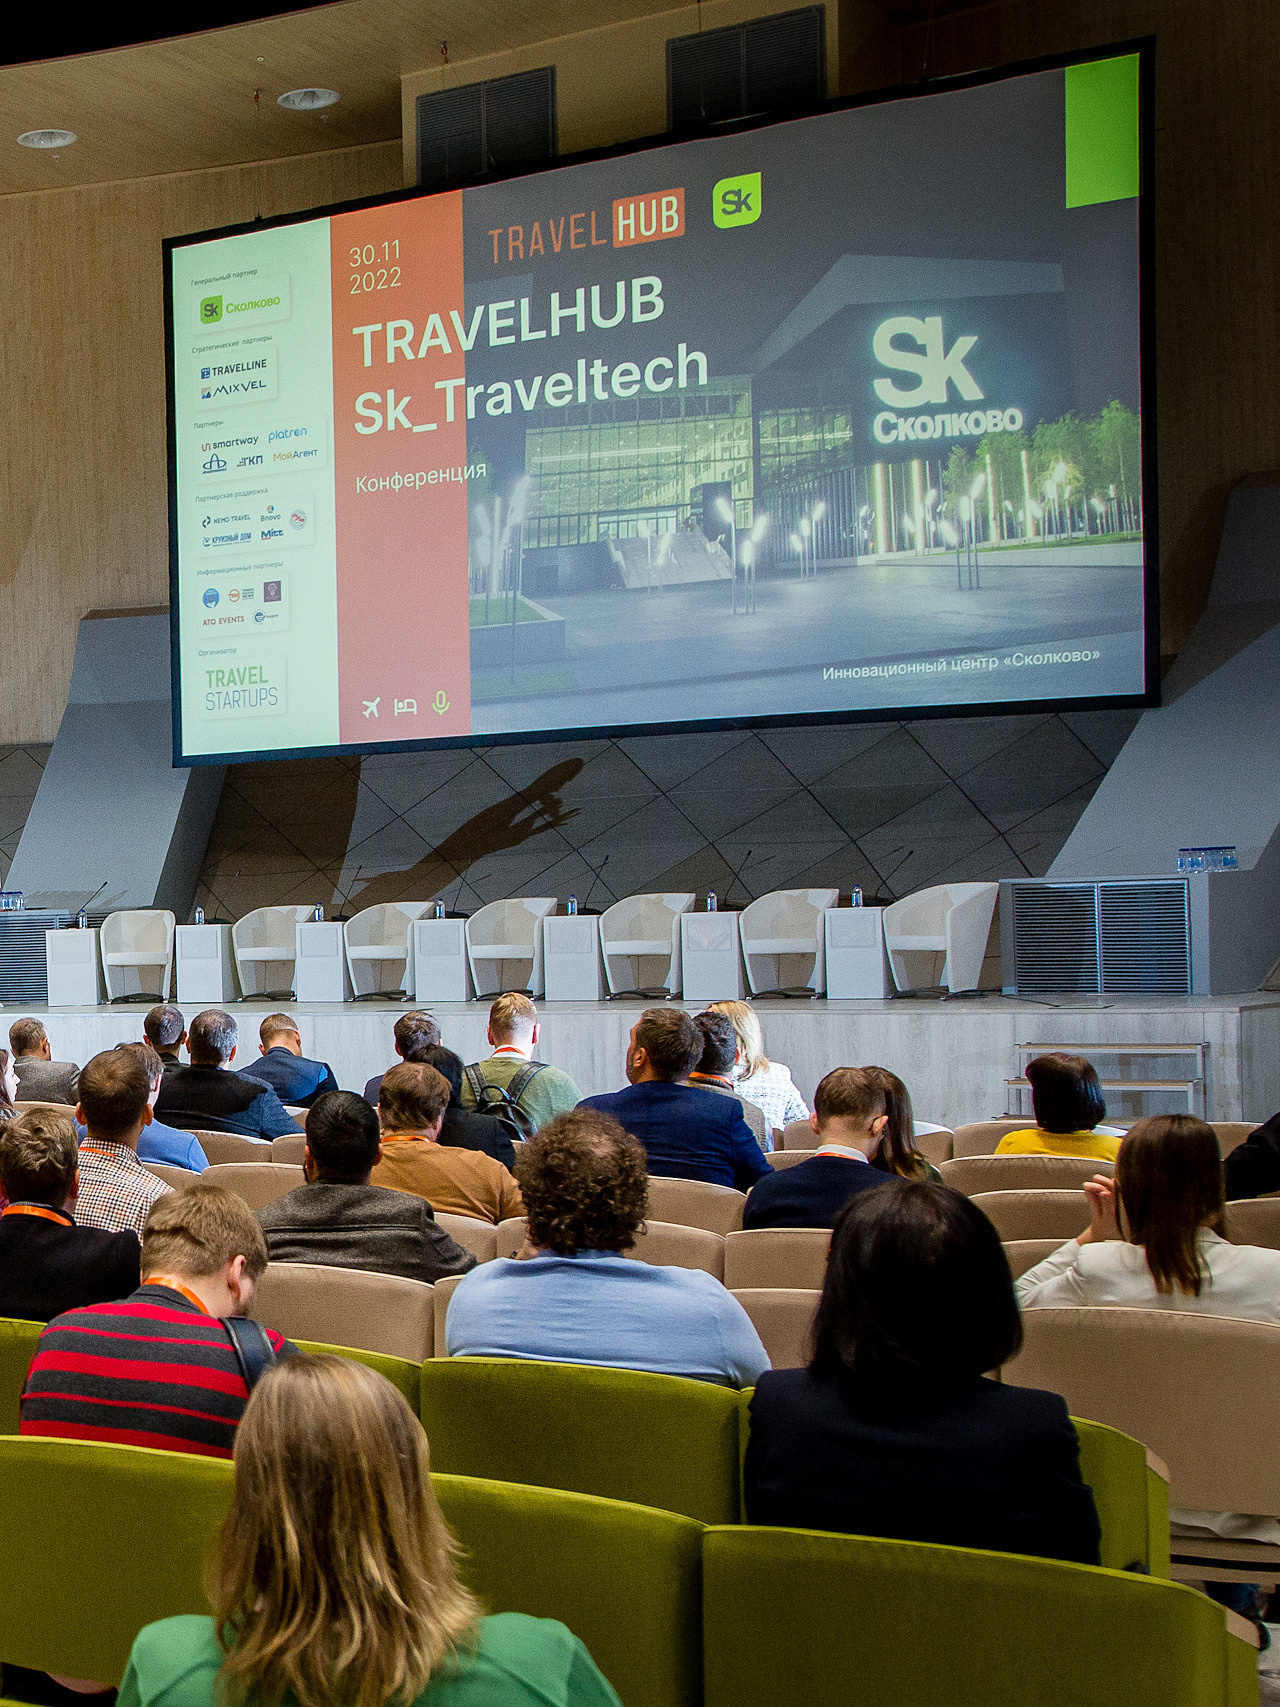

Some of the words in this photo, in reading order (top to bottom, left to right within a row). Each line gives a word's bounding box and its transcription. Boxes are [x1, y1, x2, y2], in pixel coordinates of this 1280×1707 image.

[721, 189, 753, 216] Sk
[488, 211, 607, 263] TRAVEL
[618, 196, 679, 241] HUB
[349, 239, 399, 267] 30.11
[190, 272, 232, 286] Генеральный
[232, 269, 258, 278] партнер
[349, 266, 401, 294] 2022
[204, 303, 219, 318] Sk
[226, 296, 281, 314] Сколково
[352, 275, 665, 367] TRAVELHUB
[191, 340, 240, 354] Стратегические
[212, 358, 267, 376] TRAVELLINE
[872, 316, 984, 408] Sk
[354, 342, 708, 435] Sk_Traveltech
[212, 435, 259, 450] smartway
[268, 427, 308, 444] platron
[356, 463, 487, 494] Конференция
[202, 618, 216, 626] ATO
[218, 616, 245, 625] EVENTS
[205, 665, 269, 688] TRAVEL
[822, 658, 947, 680] Инновационный
[951, 654, 999, 672] центр
[1003, 648, 1101, 667] «Сколково»
[205, 686, 278, 711] STARTUPS
